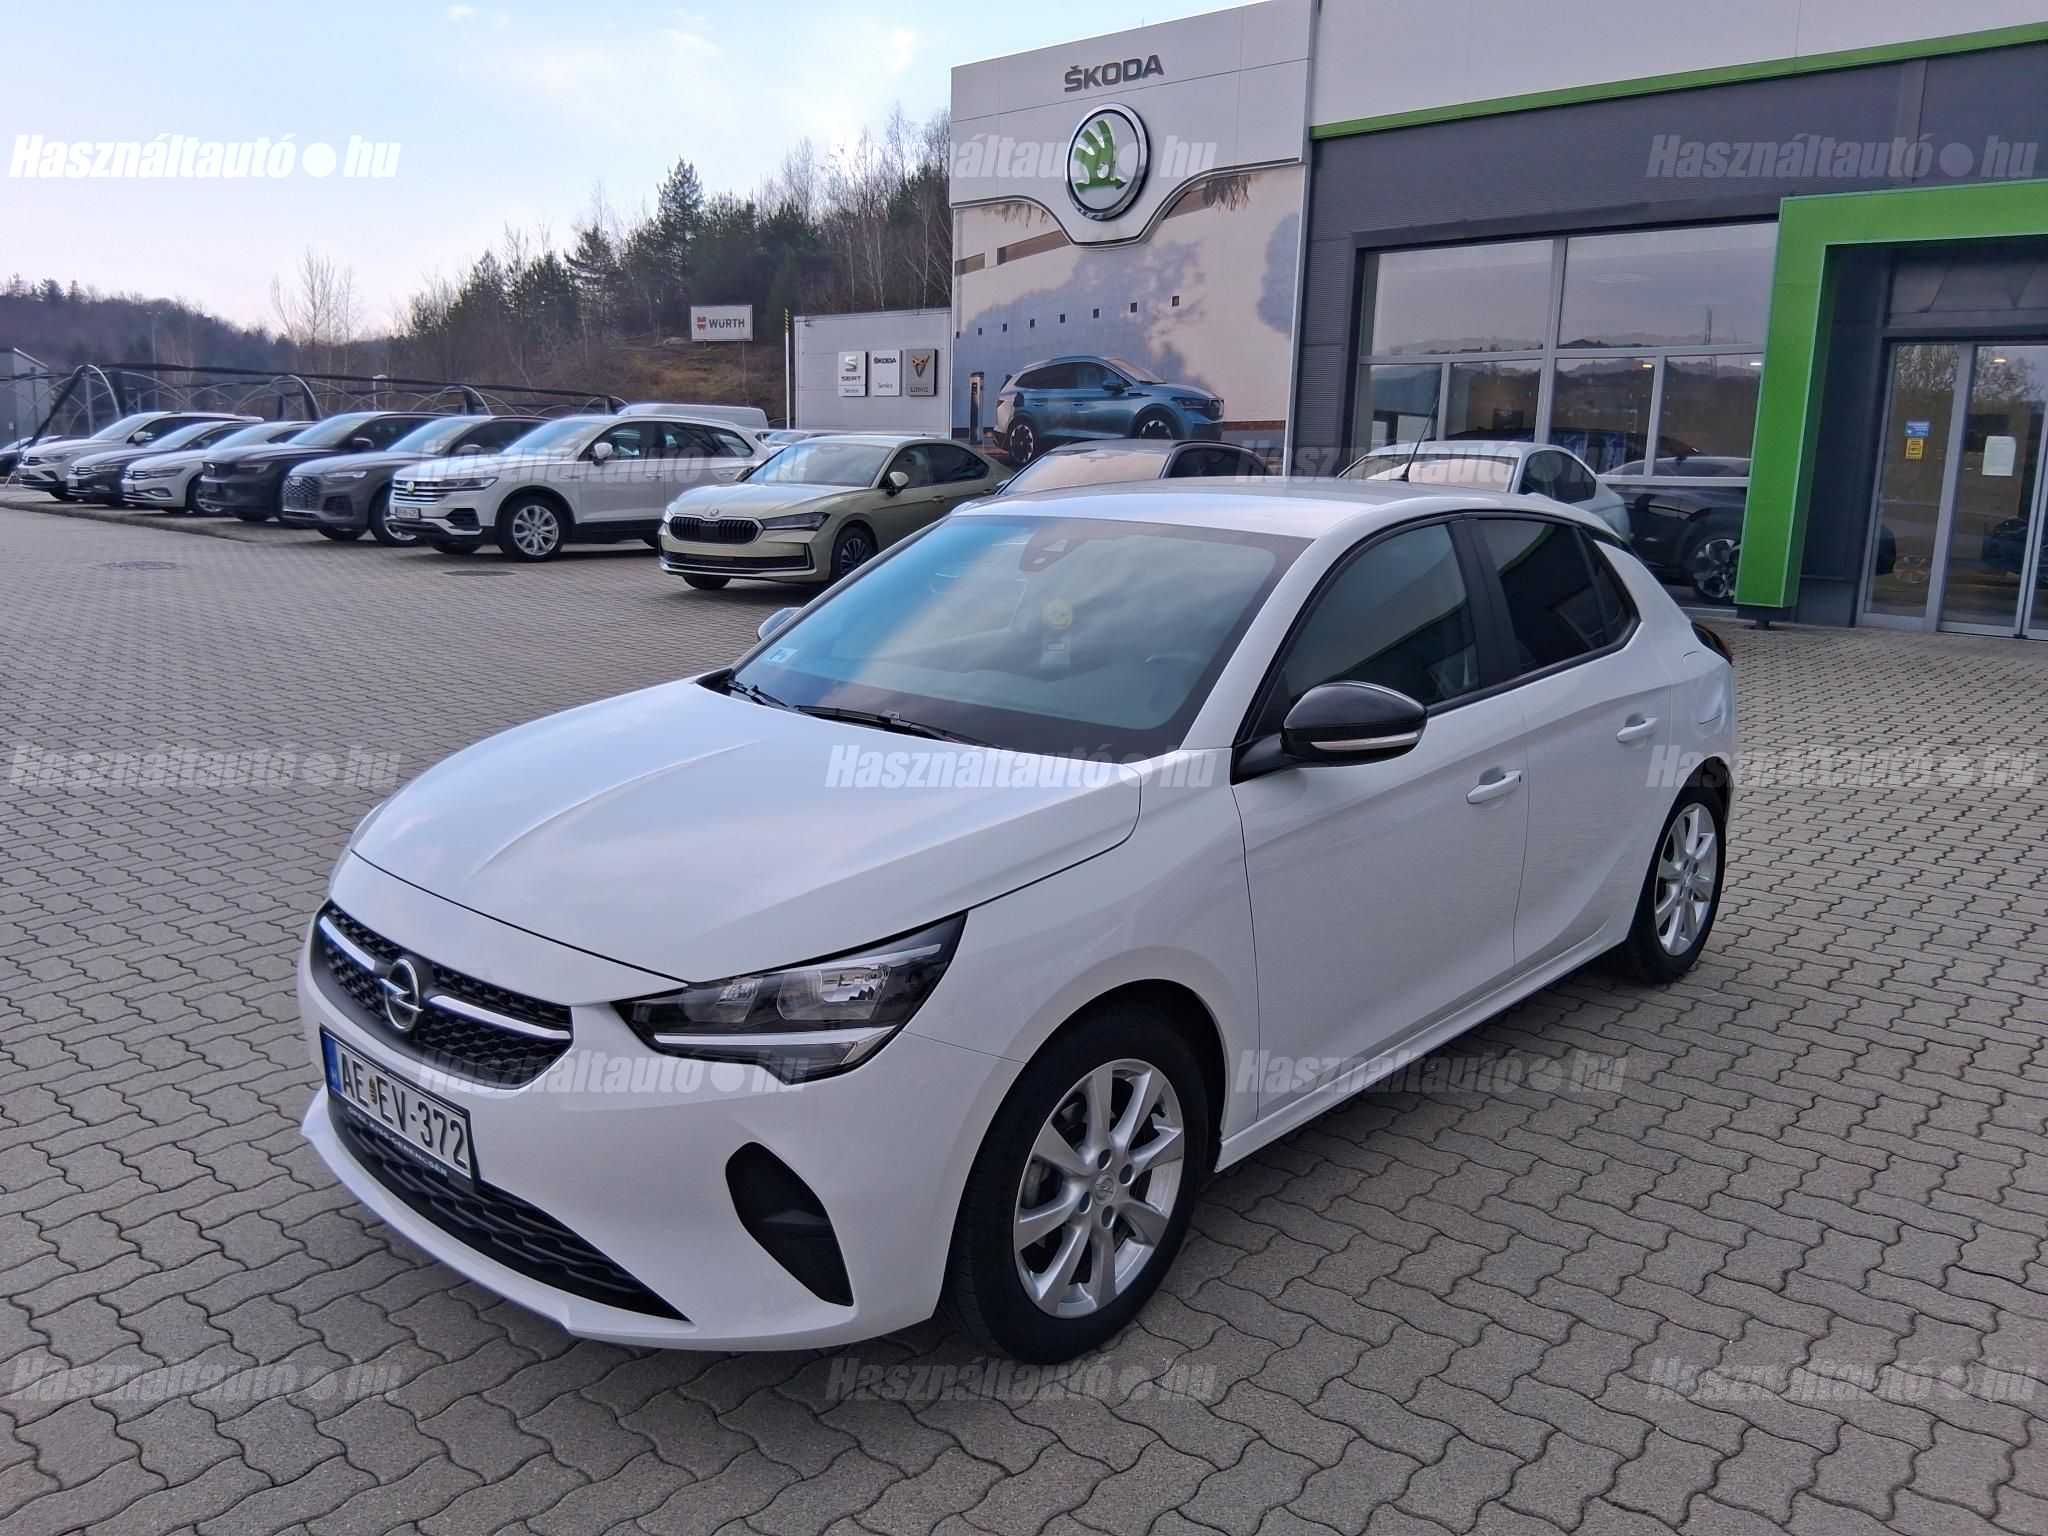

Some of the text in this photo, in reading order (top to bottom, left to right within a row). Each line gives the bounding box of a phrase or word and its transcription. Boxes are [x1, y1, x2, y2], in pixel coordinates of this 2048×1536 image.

[1064, 54, 1164, 93] ŠKODA
[709, 318, 745, 330] WÜRTH
[873, 357, 897, 365] ŠKODA
